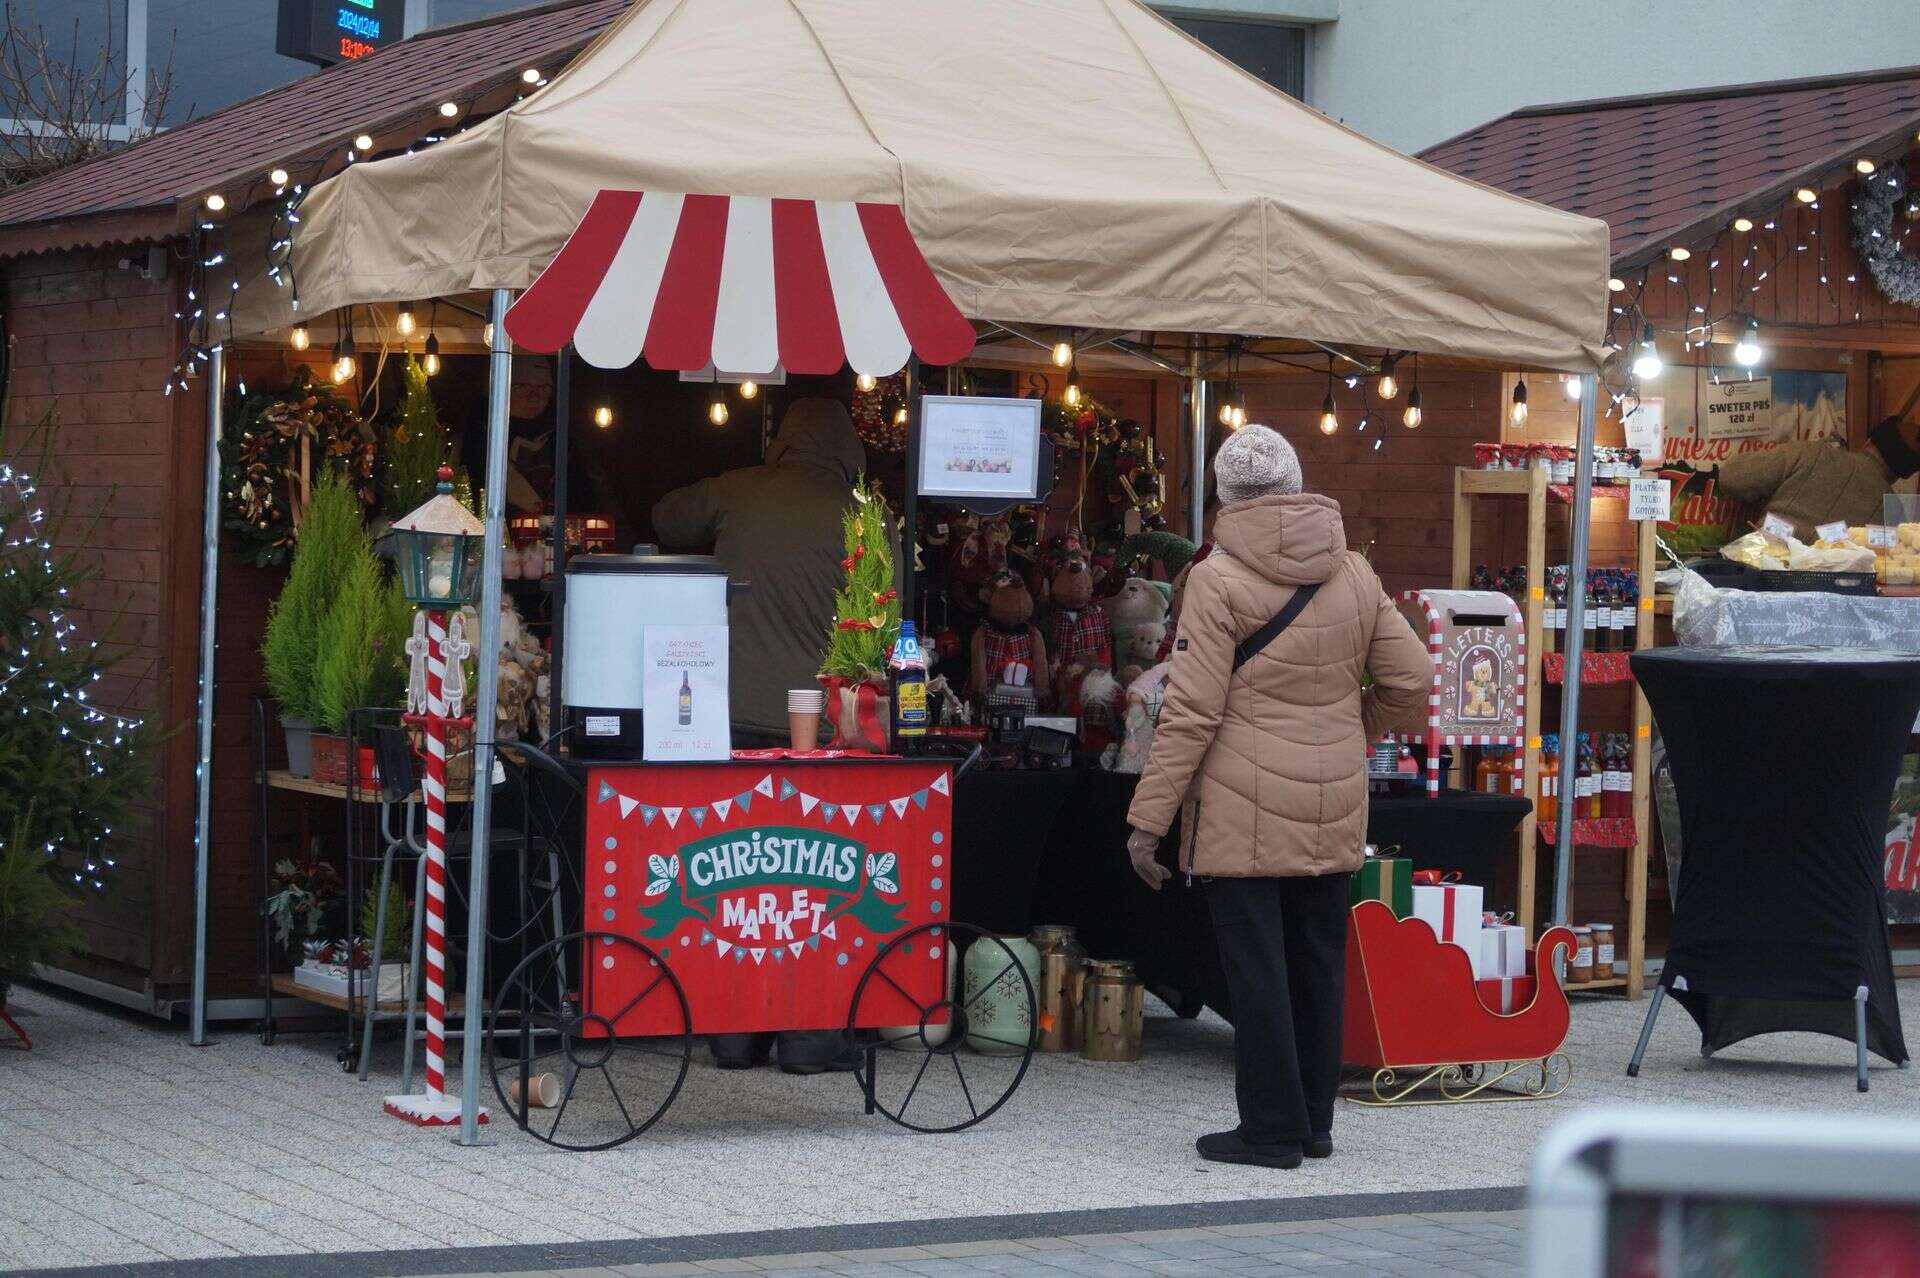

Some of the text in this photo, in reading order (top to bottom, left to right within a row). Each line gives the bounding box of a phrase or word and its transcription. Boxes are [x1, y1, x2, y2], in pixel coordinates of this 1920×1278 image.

[1708, 397, 1770, 414] SWETER PBŚ
[1729, 414, 1745, 424] 120
[1448, 627, 1512, 658] LETTERS
[723, 889, 826, 940] MARKET
